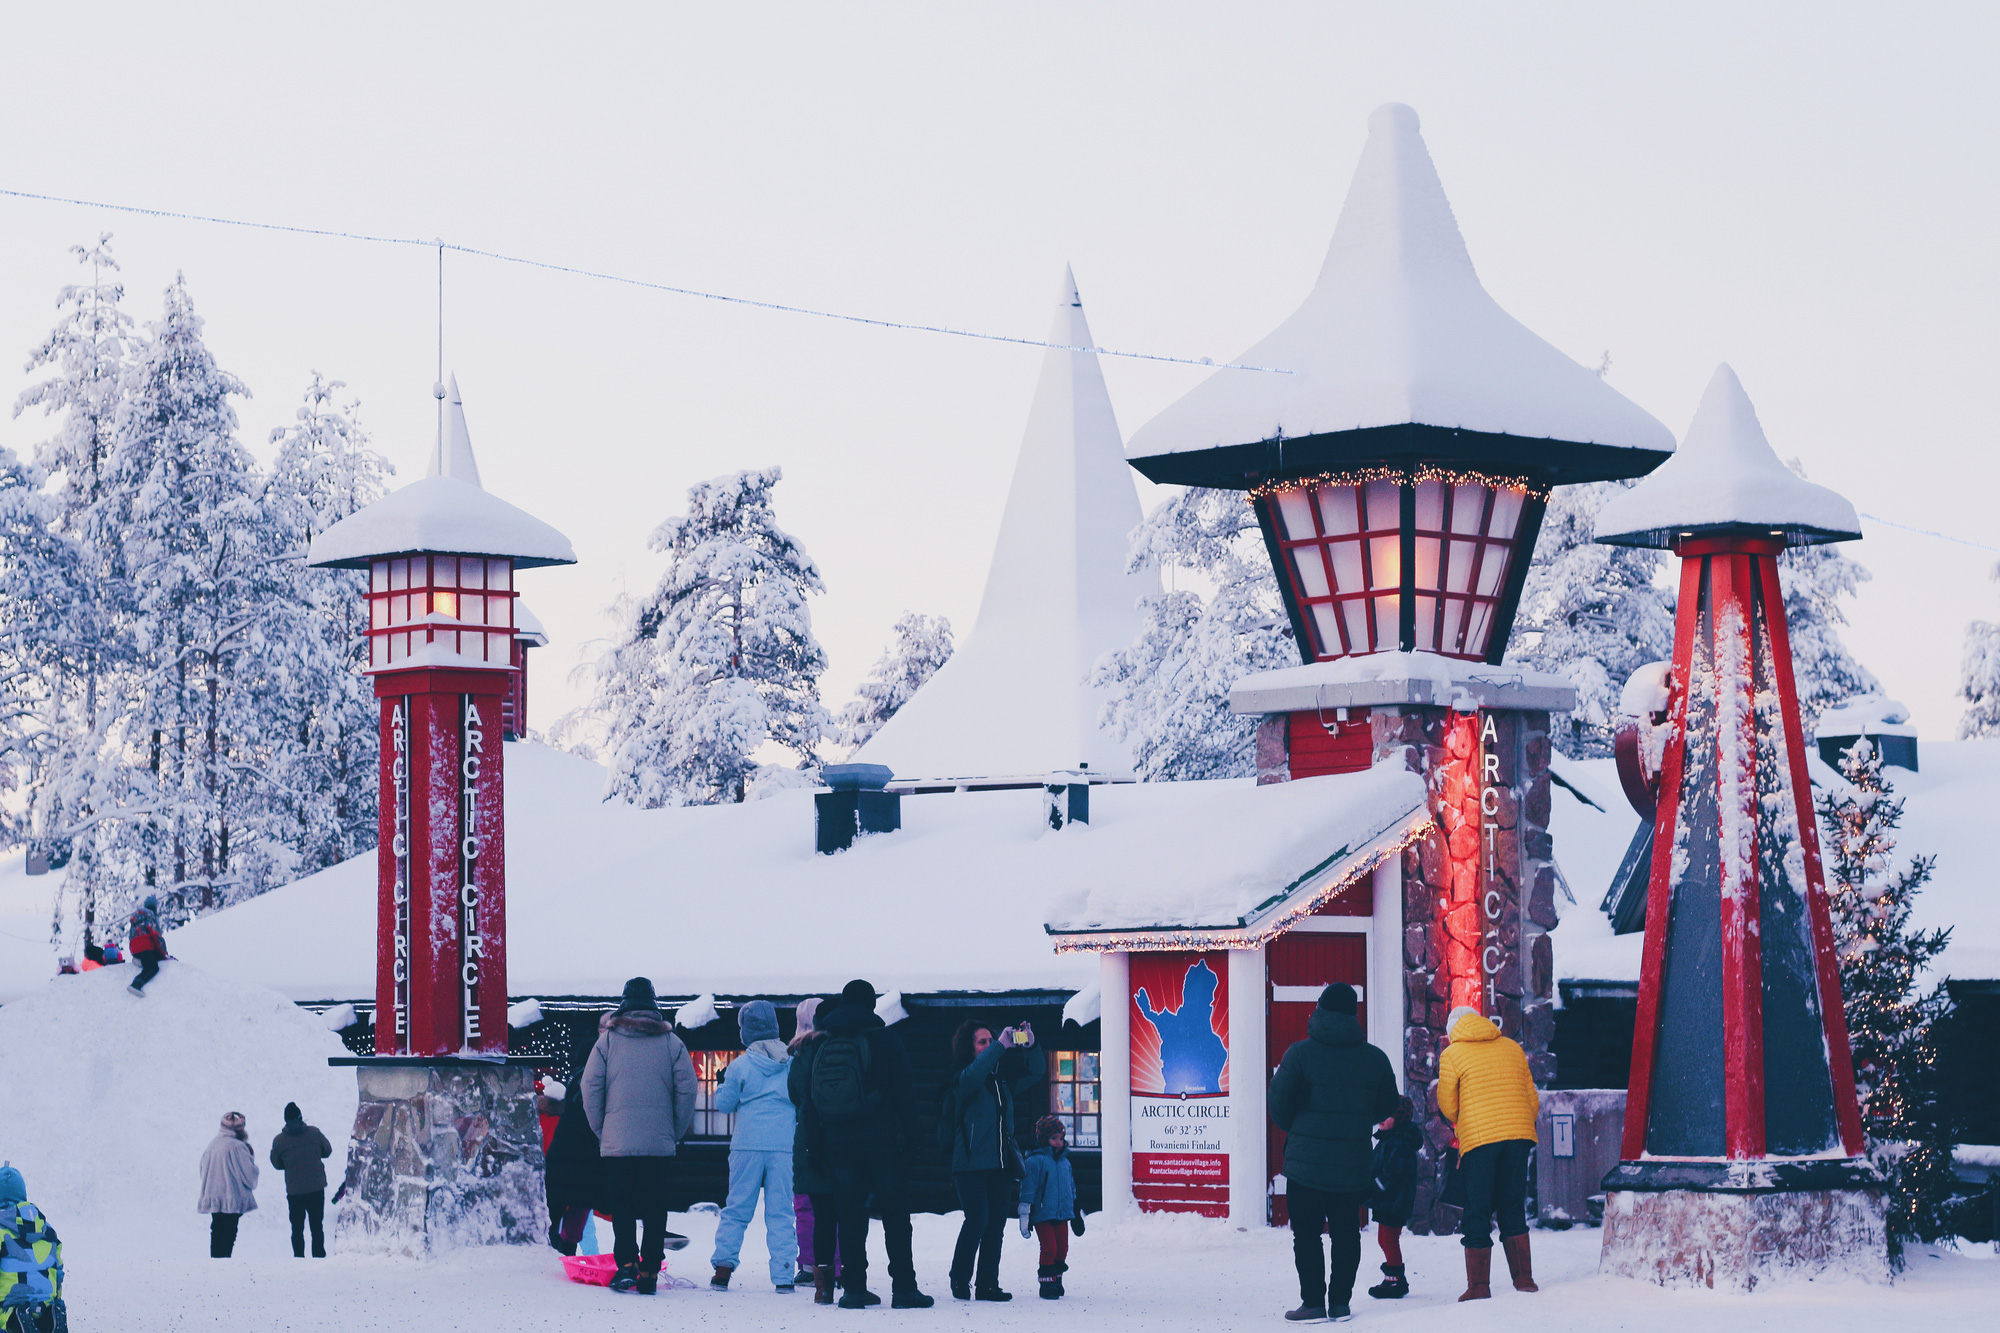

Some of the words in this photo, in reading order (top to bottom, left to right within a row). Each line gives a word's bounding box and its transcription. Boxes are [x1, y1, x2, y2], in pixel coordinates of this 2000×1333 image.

[391, 704, 404, 858] ARCTIC
[462, 704, 484, 860] ARCTIC
[1481, 714, 1501, 920] ARCTIC
[393, 880, 407, 1035] CIRCLE
[461, 883, 485, 1039] CIRCLE
[1141, 1105, 1185, 1118] ARCTIC
[1187, 1105, 1230, 1118] CIRCLE
[1150, 1140, 1190, 1150] Rovaniemi
[1192, 1140, 1221, 1150] Finland
[1164, 1125, 1178, 1135] 66°
[1149, 1159, 1221, 1167] www.santaclausvillage.info
[1149, 1168, 1193, 1176] #santaclausvillage
